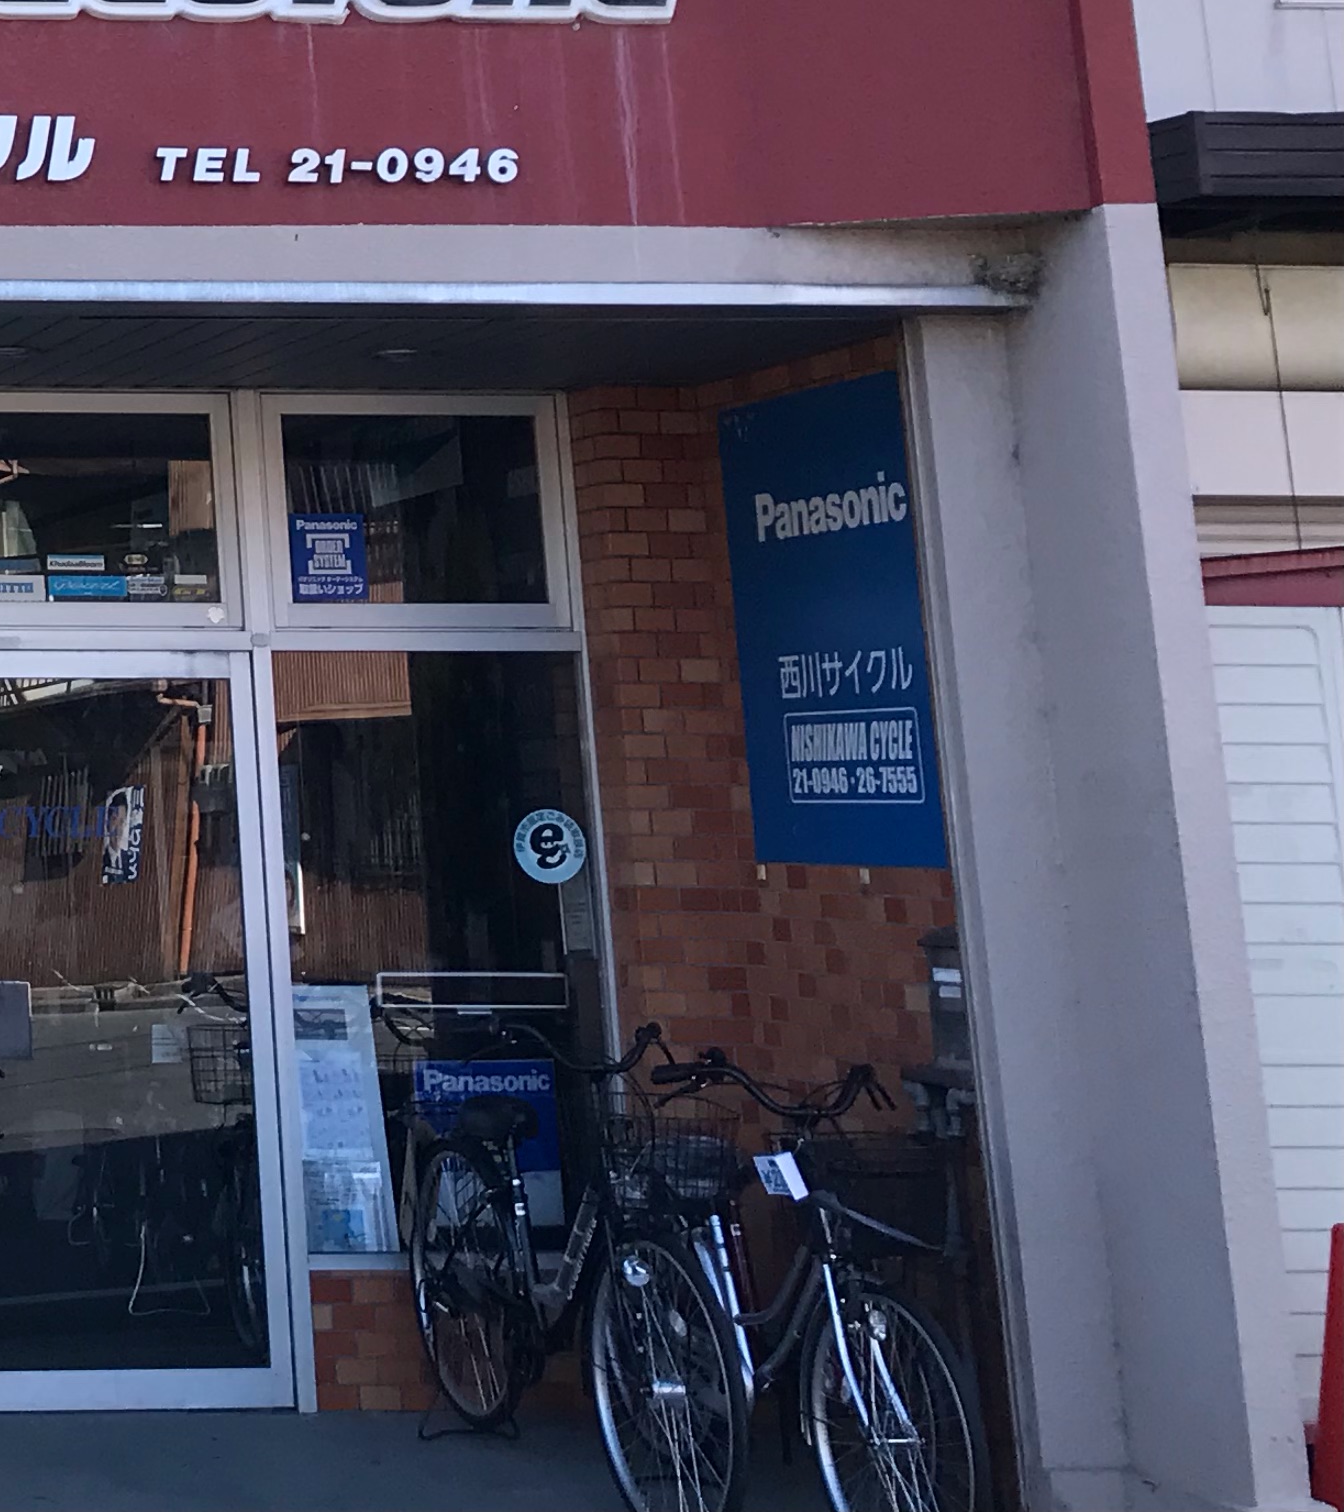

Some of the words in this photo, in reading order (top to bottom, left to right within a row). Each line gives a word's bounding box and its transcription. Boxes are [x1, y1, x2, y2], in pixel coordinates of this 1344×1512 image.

[154, 146, 261, 185] TEL
[287, 145, 520, 186] 21-0946
[296, 519, 358, 530] Panasonic
[755, 470, 909, 543] Panasonic
[778, 645, 913, 700] 西川サイクル
[790, 721, 868, 762] NISHIKAWA
[870, 719, 913, 761] CYCLE
[423, 1068, 552, 1092] Panasonic
